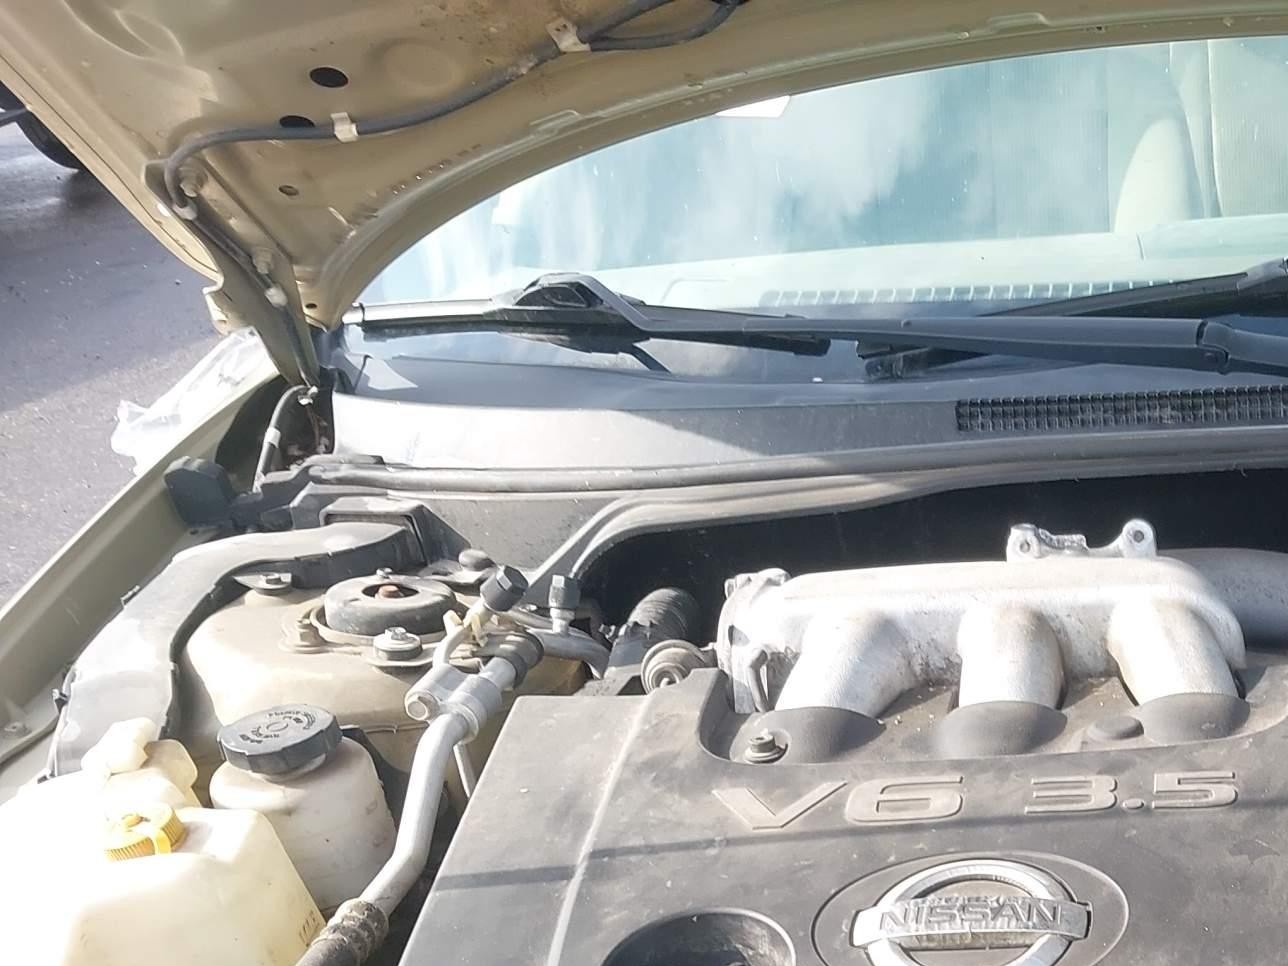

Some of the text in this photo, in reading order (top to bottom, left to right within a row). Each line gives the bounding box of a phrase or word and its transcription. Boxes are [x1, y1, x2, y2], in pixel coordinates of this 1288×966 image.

[711, 771, 1238, 831] V6 3.5
[879, 900, 1062, 931] NISSAN
